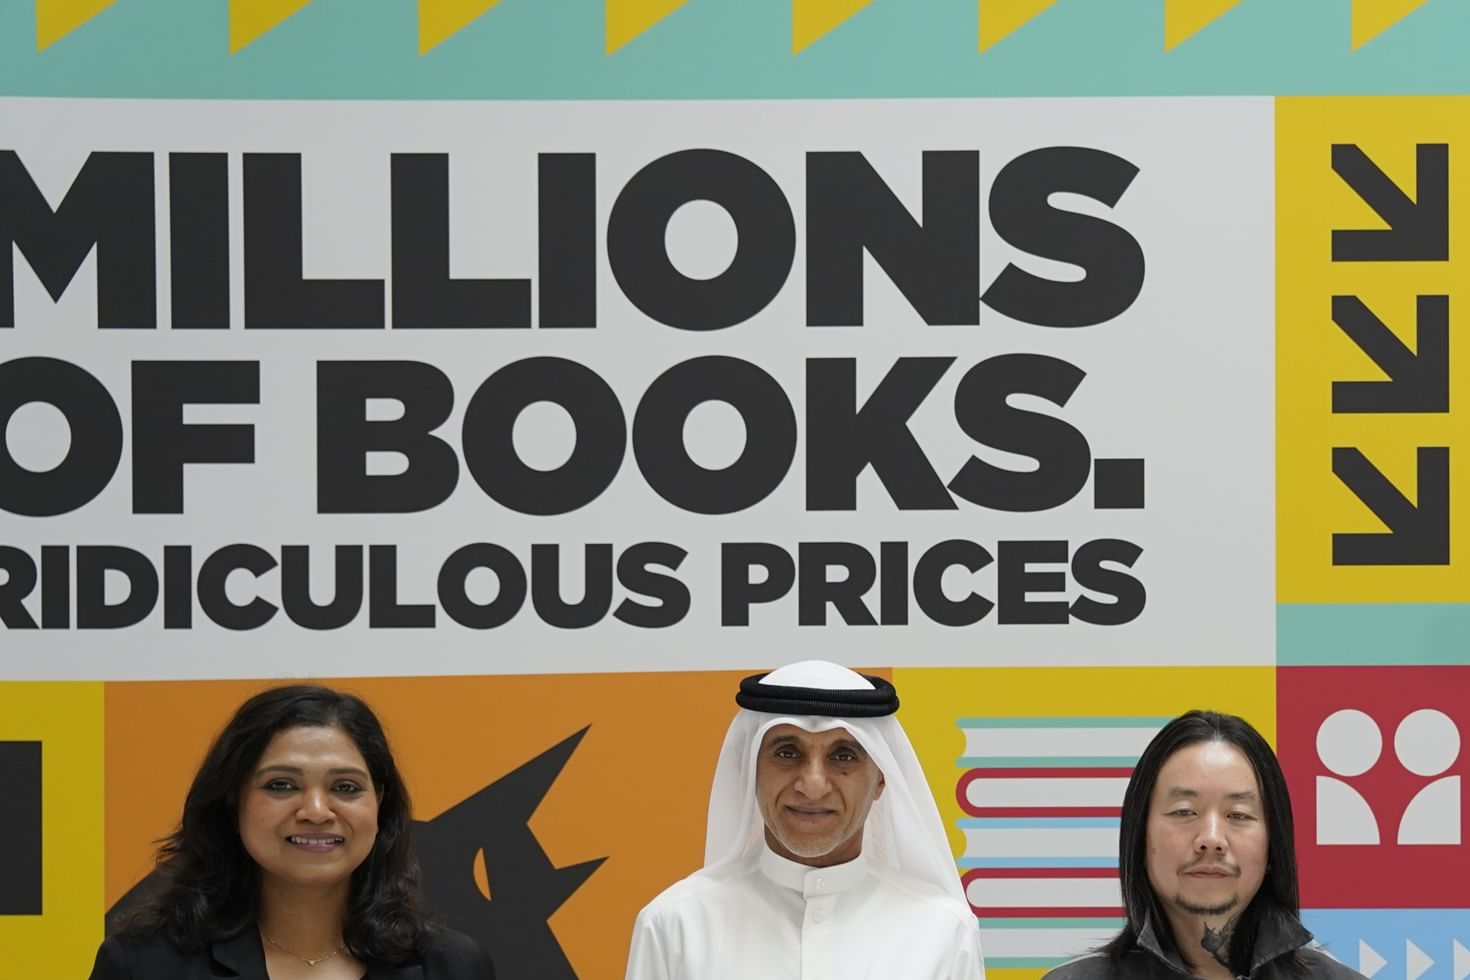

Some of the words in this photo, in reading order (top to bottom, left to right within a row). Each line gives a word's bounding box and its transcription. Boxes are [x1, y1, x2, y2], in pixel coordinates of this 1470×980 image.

[0, 147, 1146, 331] MILLIONS
[0, 356, 260, 517] OF
[317, 353, 1145, 517] BOOKS.
[721, 539, 1146, 627] PRICES
